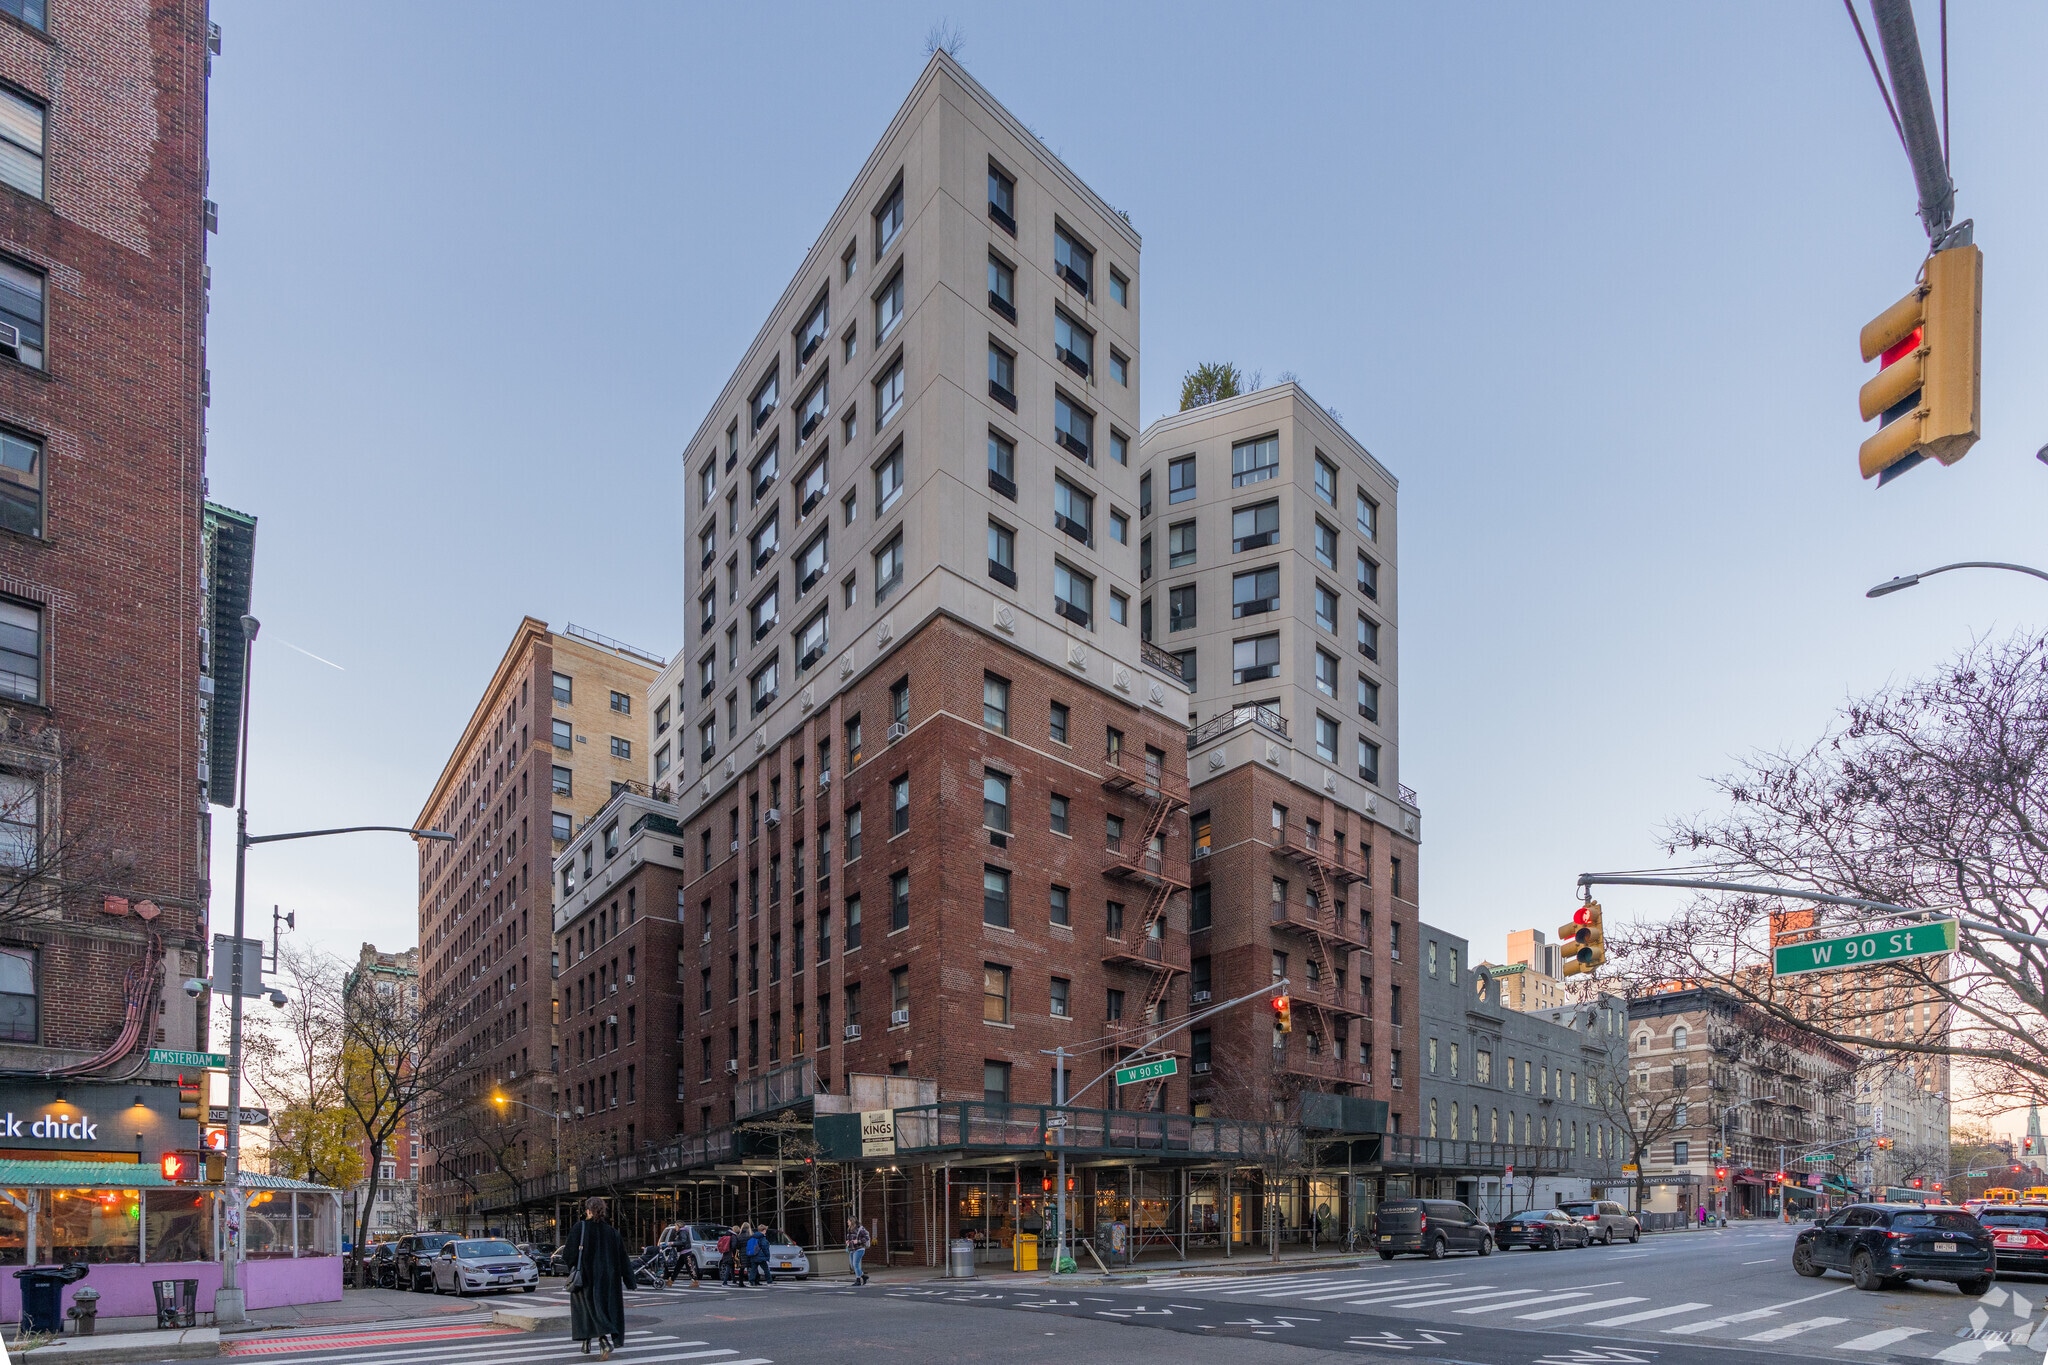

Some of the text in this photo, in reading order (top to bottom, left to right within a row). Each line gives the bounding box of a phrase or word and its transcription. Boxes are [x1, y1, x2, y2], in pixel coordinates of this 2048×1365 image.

[1812, 932, 1914, 965] W 90 St
[153, 1050, 213, 1066] AMSTERDAM
[1128, 1064, 1163, 1080] W 90 St
[240, 1112, 259, 1121] WAY
[30, 1114, 98, 1140] chick
[863, 1123, 892, 1136] KINGS
